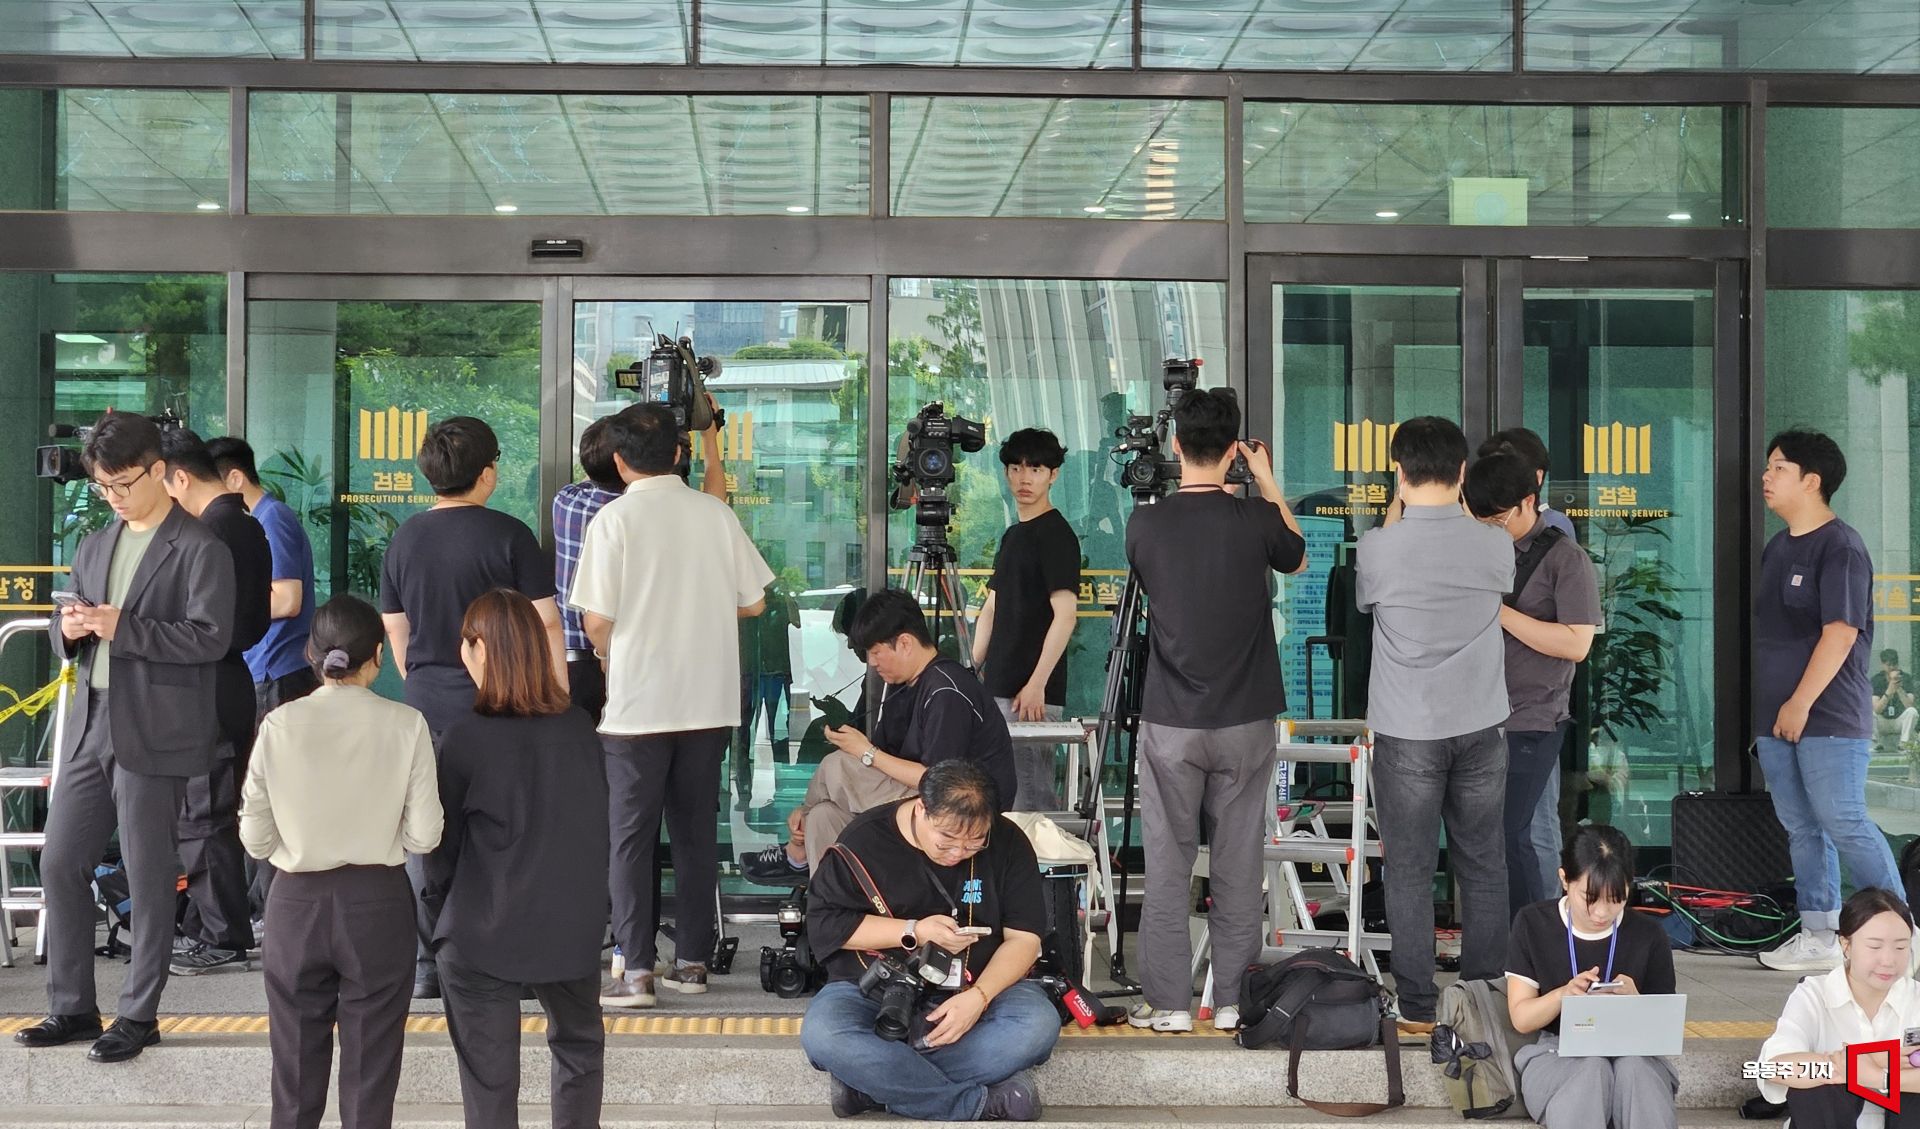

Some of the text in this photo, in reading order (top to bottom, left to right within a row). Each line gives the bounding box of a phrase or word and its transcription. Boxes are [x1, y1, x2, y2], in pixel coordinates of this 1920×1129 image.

[373, 471, 414, 491] 검찰
[340, 494, 440, 504] PROSECUTION SERVIC
[733, 496, 771, 505] SERVICE
[1347, 484, 1387, 503] 검찰
[1597, 486, 1637, 505] 검찰
[1315, 506, 1378, 515] PROSECUTION
[1565, 508, 1669, 518] PROSECUTION SERVICE
[872, 895, 886, 914] EOS
